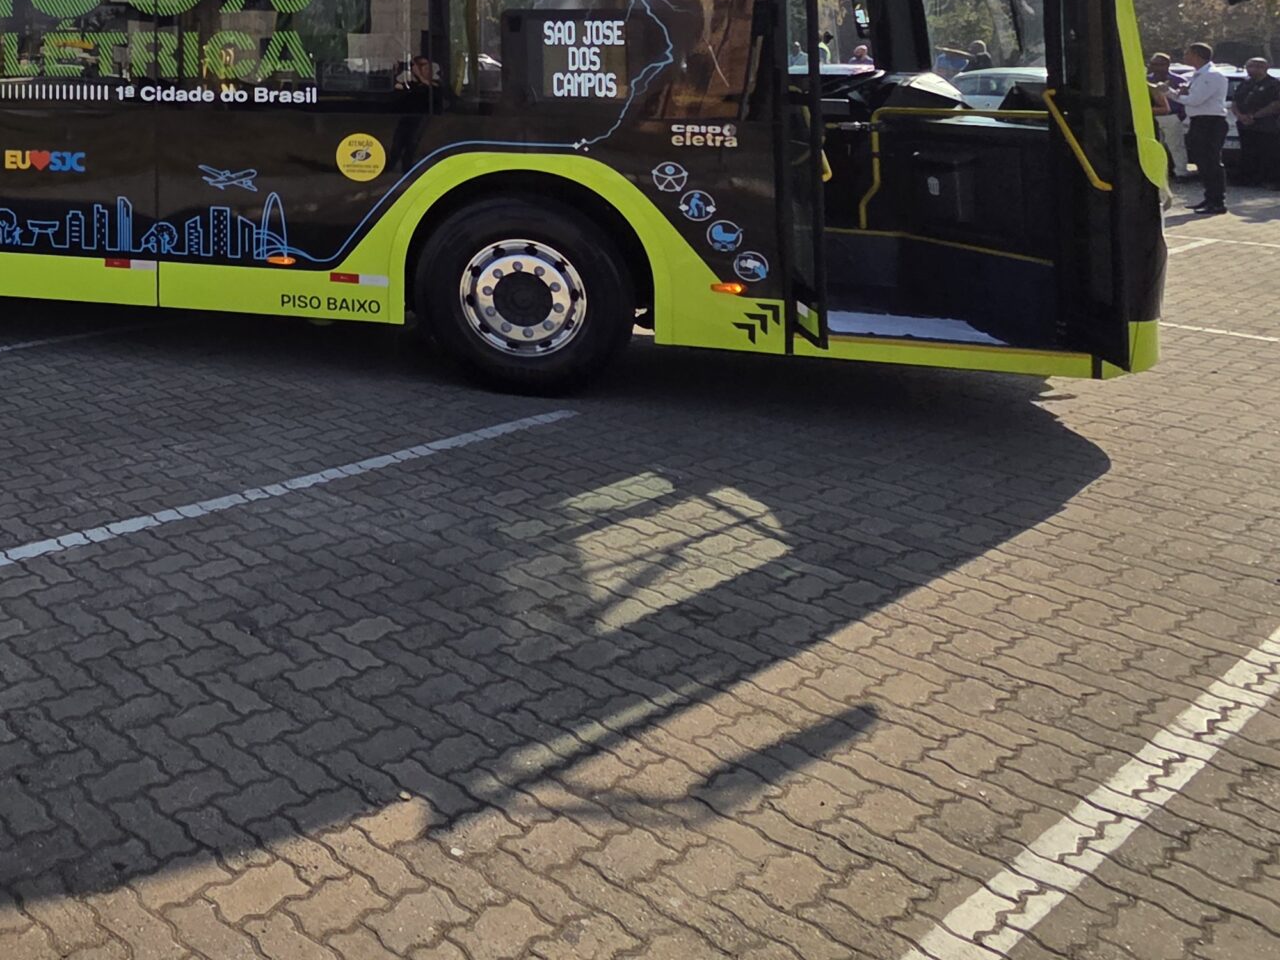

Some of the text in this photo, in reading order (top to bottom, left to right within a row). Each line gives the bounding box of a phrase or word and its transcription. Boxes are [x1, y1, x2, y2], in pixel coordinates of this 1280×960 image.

[543, 21, 625, 45] SAO JOSE
[567, 47, 601, 71] DOS
[140, 85, 215, 102] Cidade
[220, 86, 248, 103] do
[254, 87, 317, 104] Brasil
[552, 73, 617, 97] CAMPOS
[671, 133, 738, 147] eletra
[4, 149, 86, 172] EU SJC
[280, 293, 381, 314] PISO BAIXO
